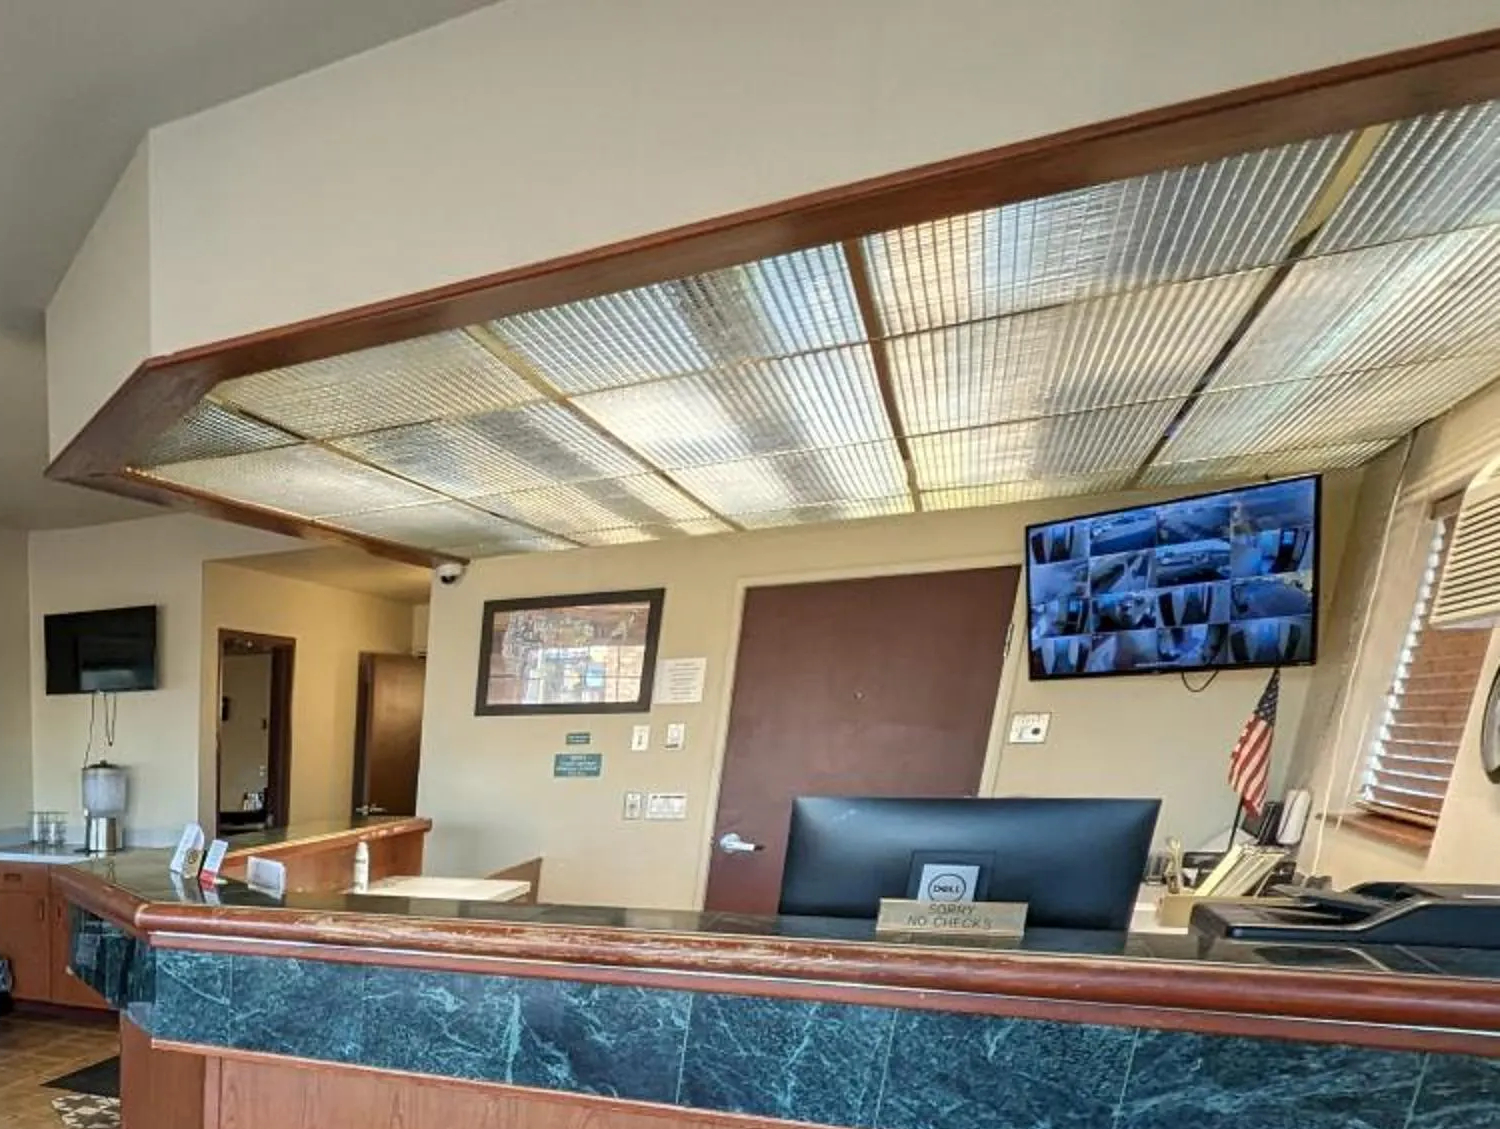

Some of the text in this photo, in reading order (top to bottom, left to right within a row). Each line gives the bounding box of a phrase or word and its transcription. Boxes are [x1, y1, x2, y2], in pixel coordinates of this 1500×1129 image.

[933, 884, 959, 893] DELL
[928, 903, 974, 915] SORRY
[907, 915, 992, 929] NO CHECKS
